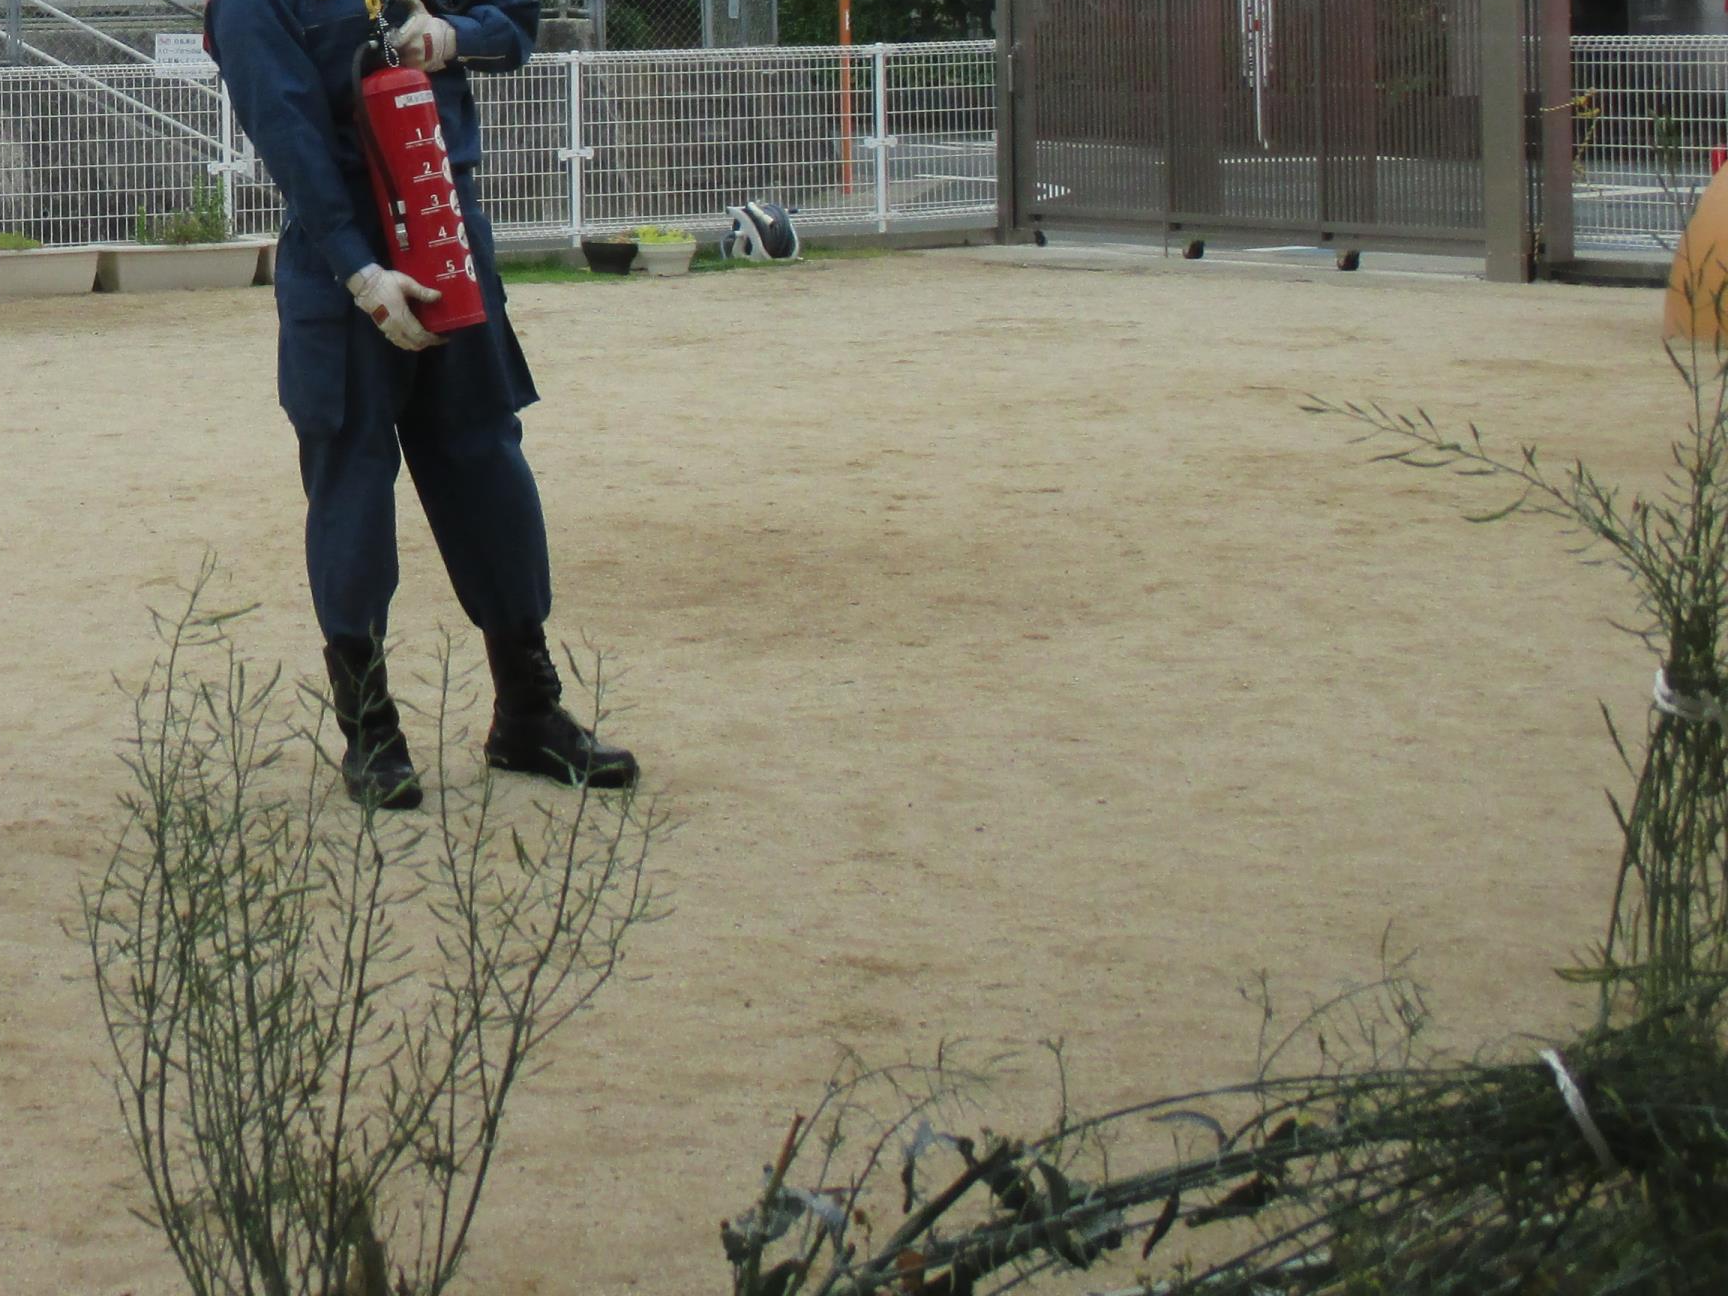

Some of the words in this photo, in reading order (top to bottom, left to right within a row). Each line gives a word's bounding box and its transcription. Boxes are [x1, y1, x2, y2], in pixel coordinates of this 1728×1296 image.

[422, 161, 434, 175] 2
[430, 194, 440, 207] 3
[438, 226, 448, 239] 4
[446, 259, 456, 273] 5
